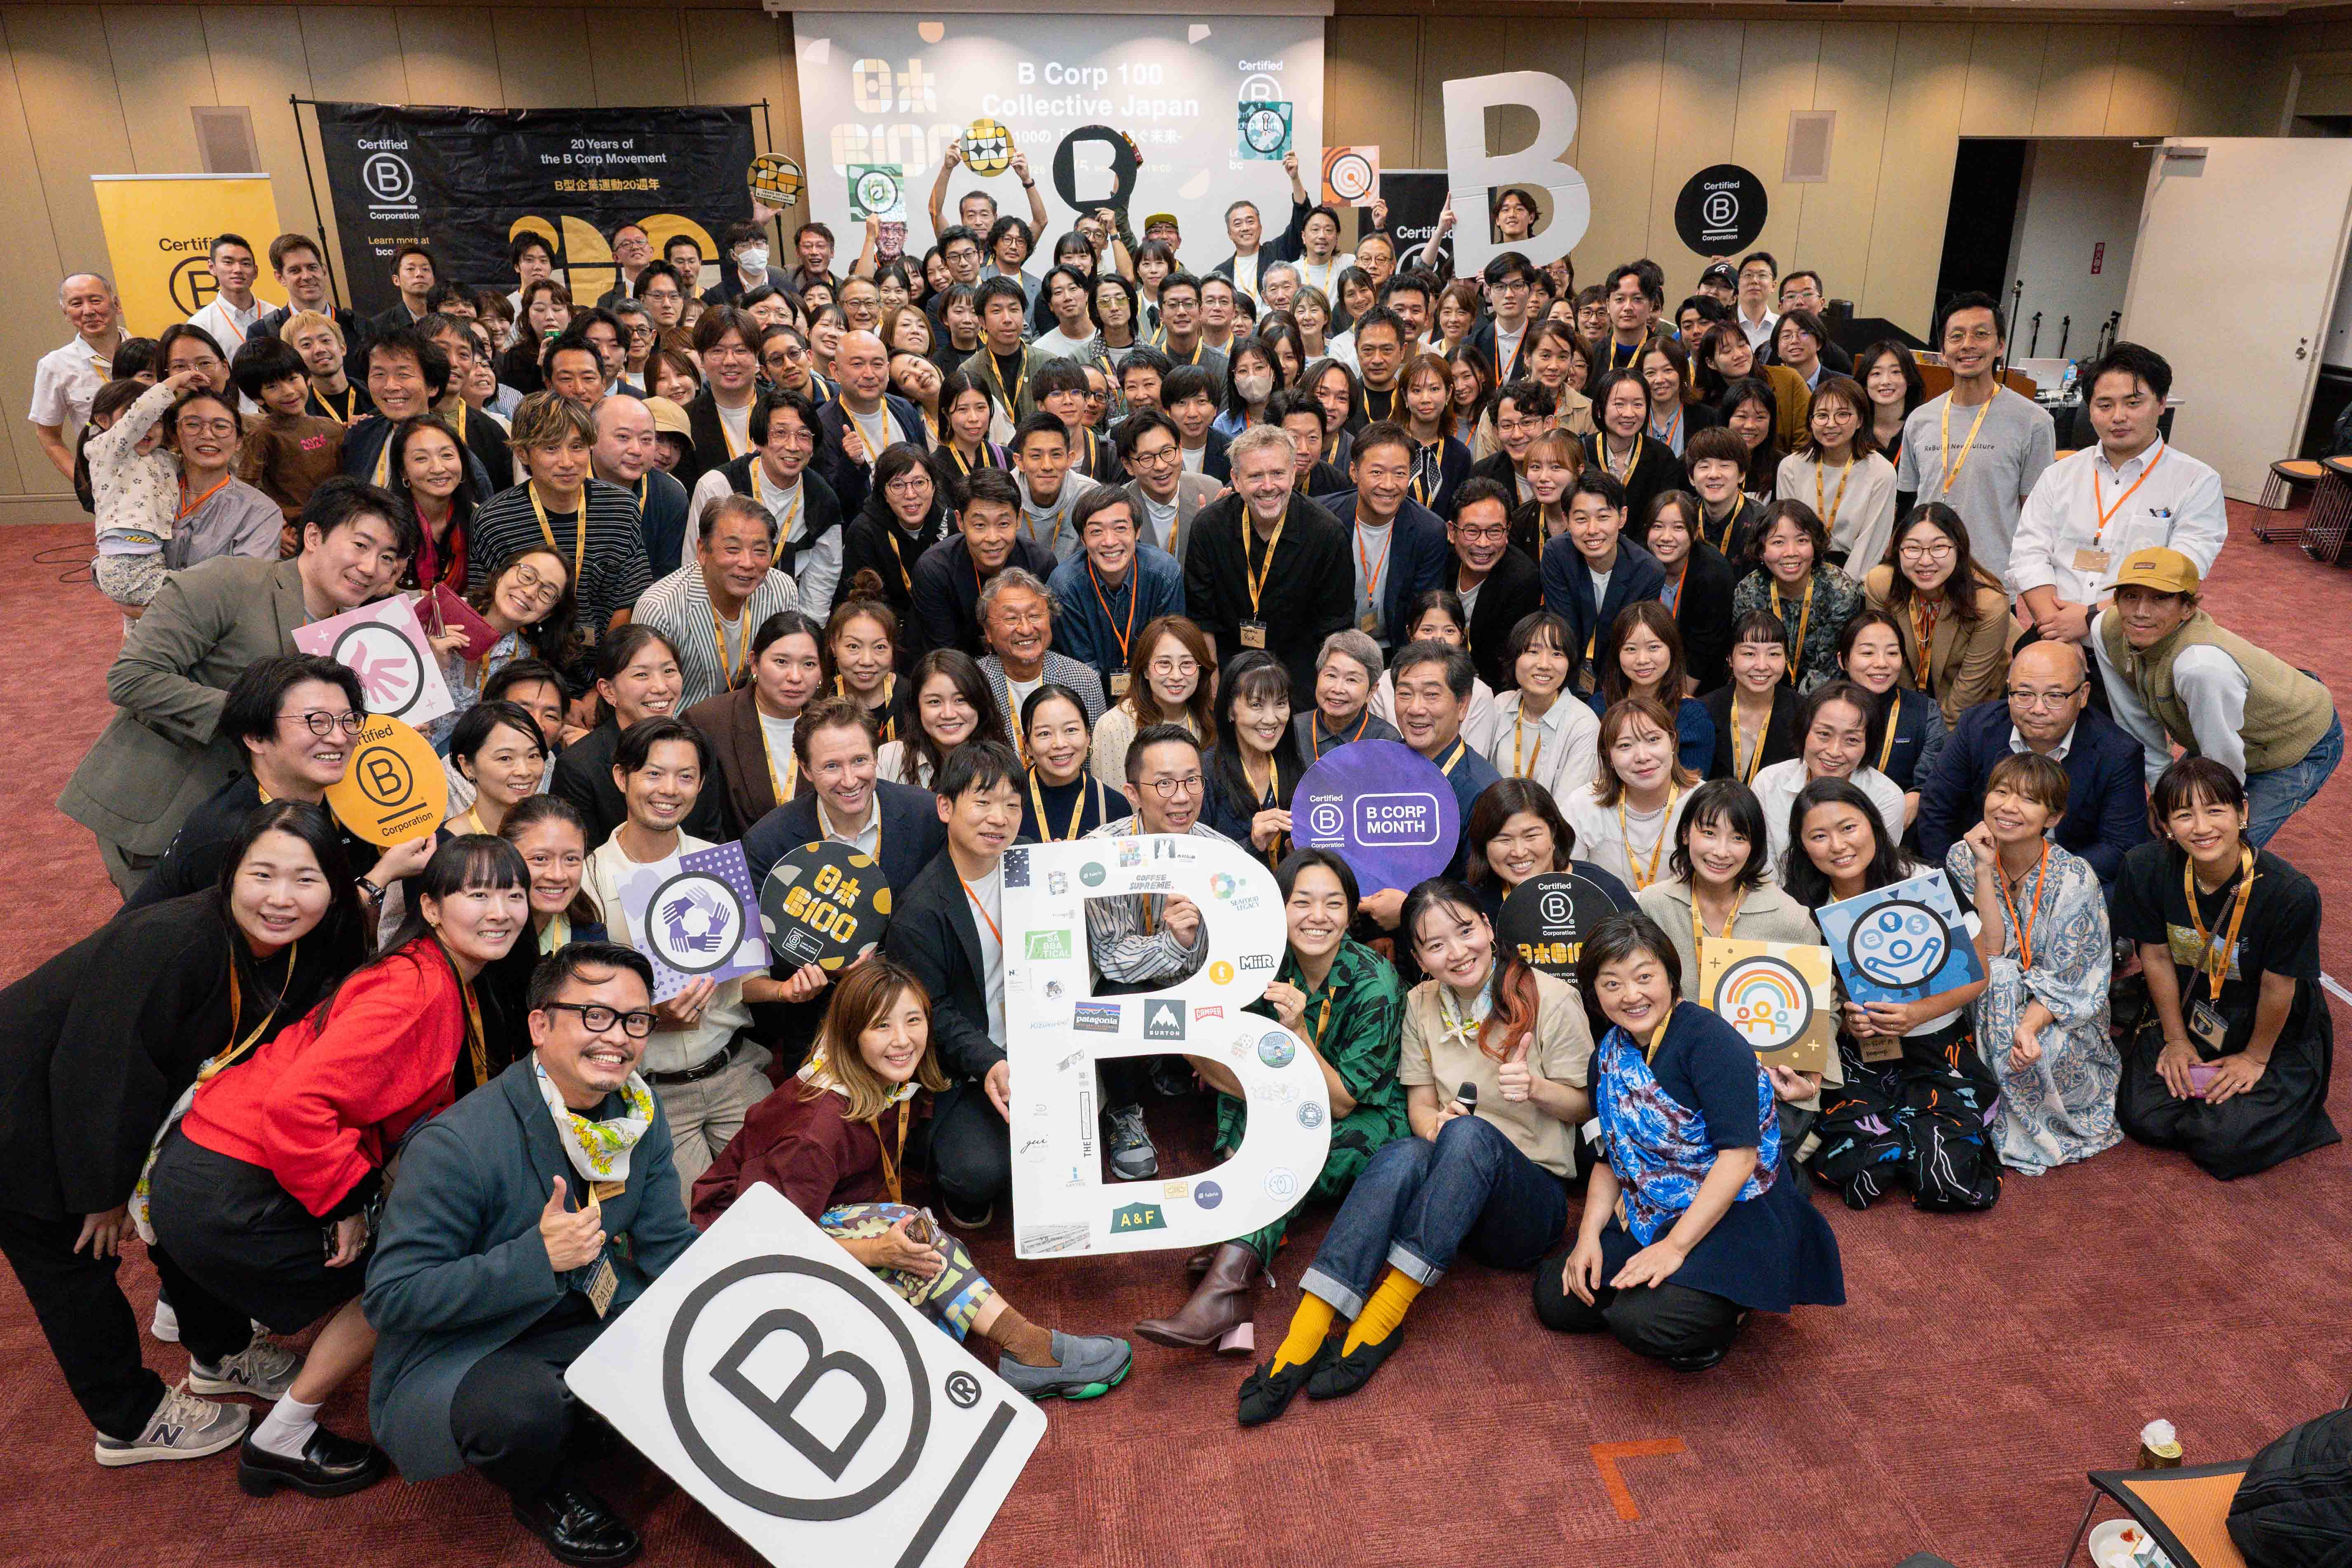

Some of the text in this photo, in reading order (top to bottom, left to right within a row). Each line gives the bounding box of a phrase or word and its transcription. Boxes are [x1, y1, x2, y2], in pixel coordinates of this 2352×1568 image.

[1238, 60, 1283, 71] Certified
[1018, 62, 1162, 90] B Corp 100
[982, 94, 1200, 120] Collective Japan
[358, 139, 408, 149] Certified
[571, 139, 633, 149] 20 Years of
[541, 153, 667, 165] the B Corp Movement
[376, 163, 402, 191] B
[555, 179, 660, 191] B型企業運動20週年
[1704, 181, 1740, 190] Certified
[1712, 199, 1729, 219] B
[370, 212, 420, 221] Corporation
[358, 724, 393, 745] rtified
[367, 758, 402, 797] B
[1366, 805, 1427, 819] B CORP
[382, 812, 433, 837] Corporation
[1319, 810, 1336, 829] B
[1367, 820, 1425, 834] MONTH
[1538, 882, 1571, 891] Certified
[1230, 896, 1259, 906] SEAFOOD
[1237, 901, 1260, 911] LEGACY
[1549, 898, 1566, 917] B
[799, 943, 816, 955] bcorp.com
[1042, 950, 1071, 958] TICAL
[1196, 1007, 1222, 1018] CAMPER
[1076, 1016, 1118, 1025] patagonia
[1121, 1210, 1155, 1227] A & F
[596, 1273, 614, 1309] DAVE
[709, 1308, 887, 1483] B
